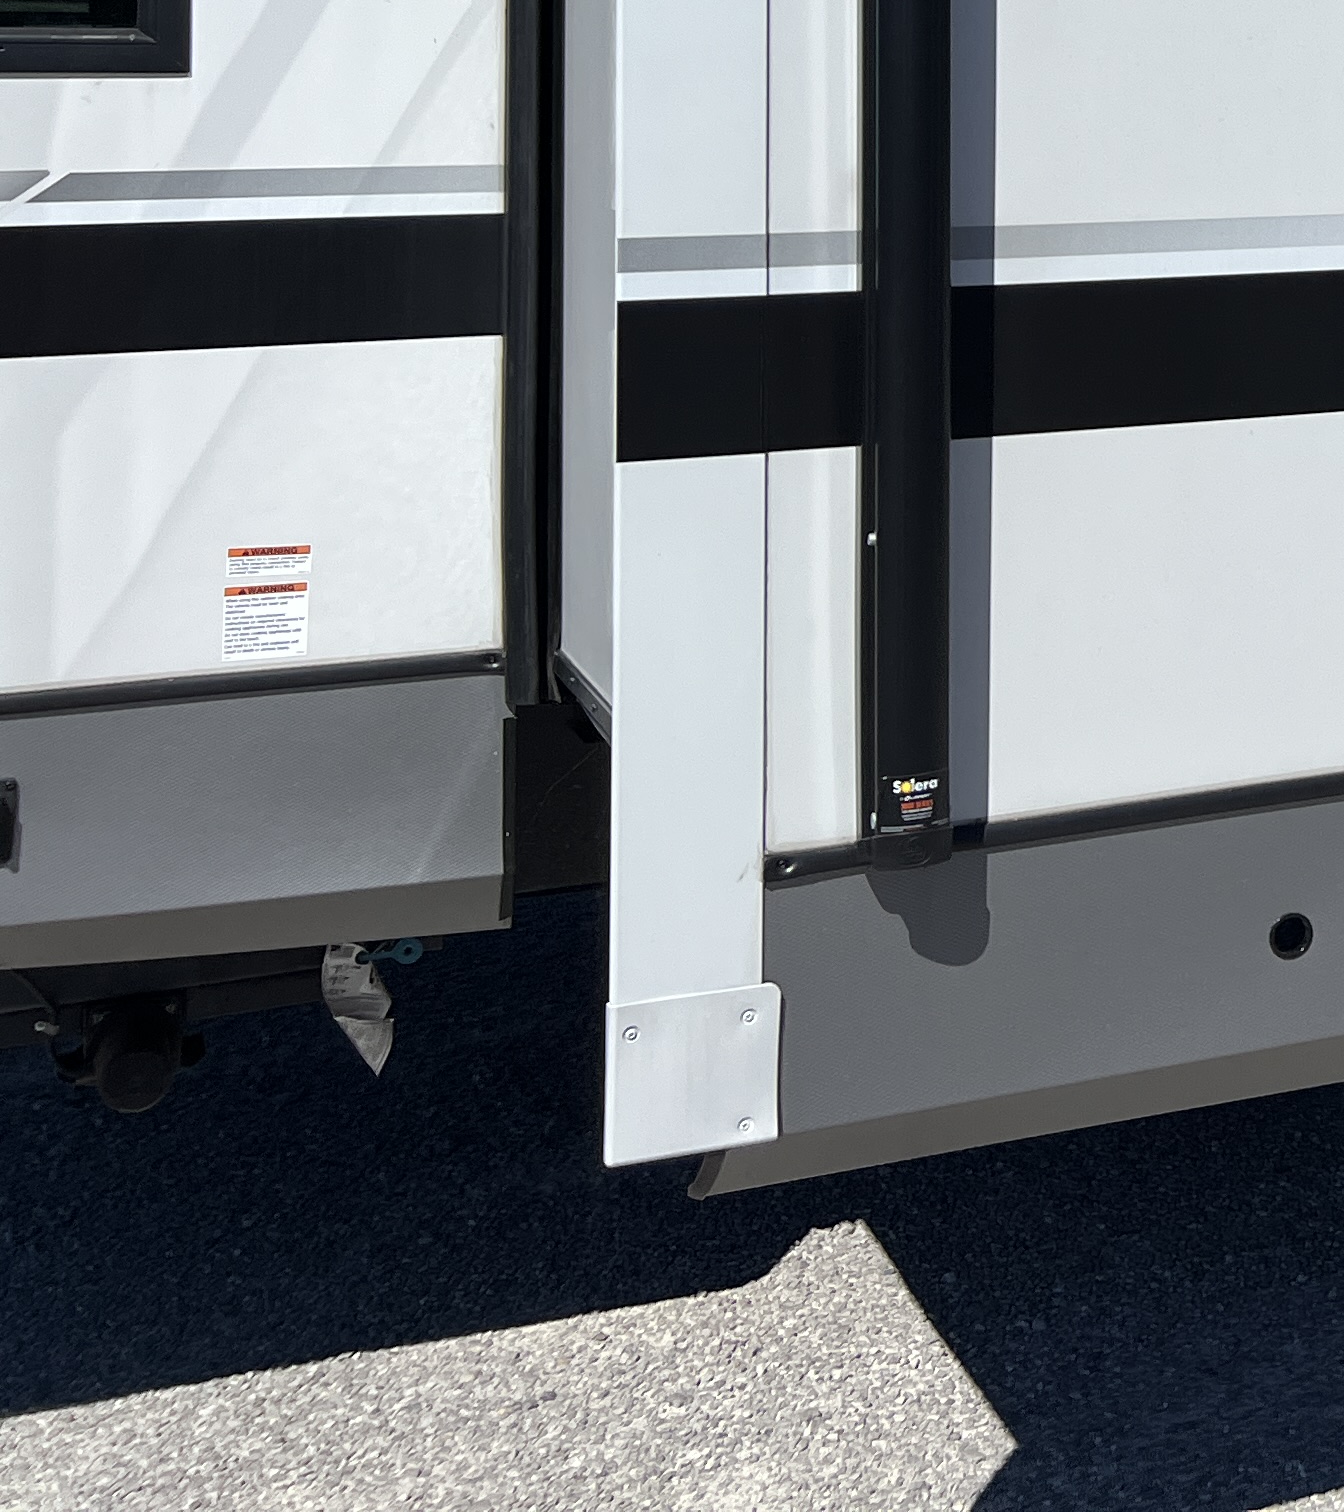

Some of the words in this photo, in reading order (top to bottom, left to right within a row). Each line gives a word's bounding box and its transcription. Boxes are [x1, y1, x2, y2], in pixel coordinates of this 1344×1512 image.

[251, 547, 298, 556] WARNING
[247, 584, 295, 595] WARNING
[892, 778, 938, 794] Solera
